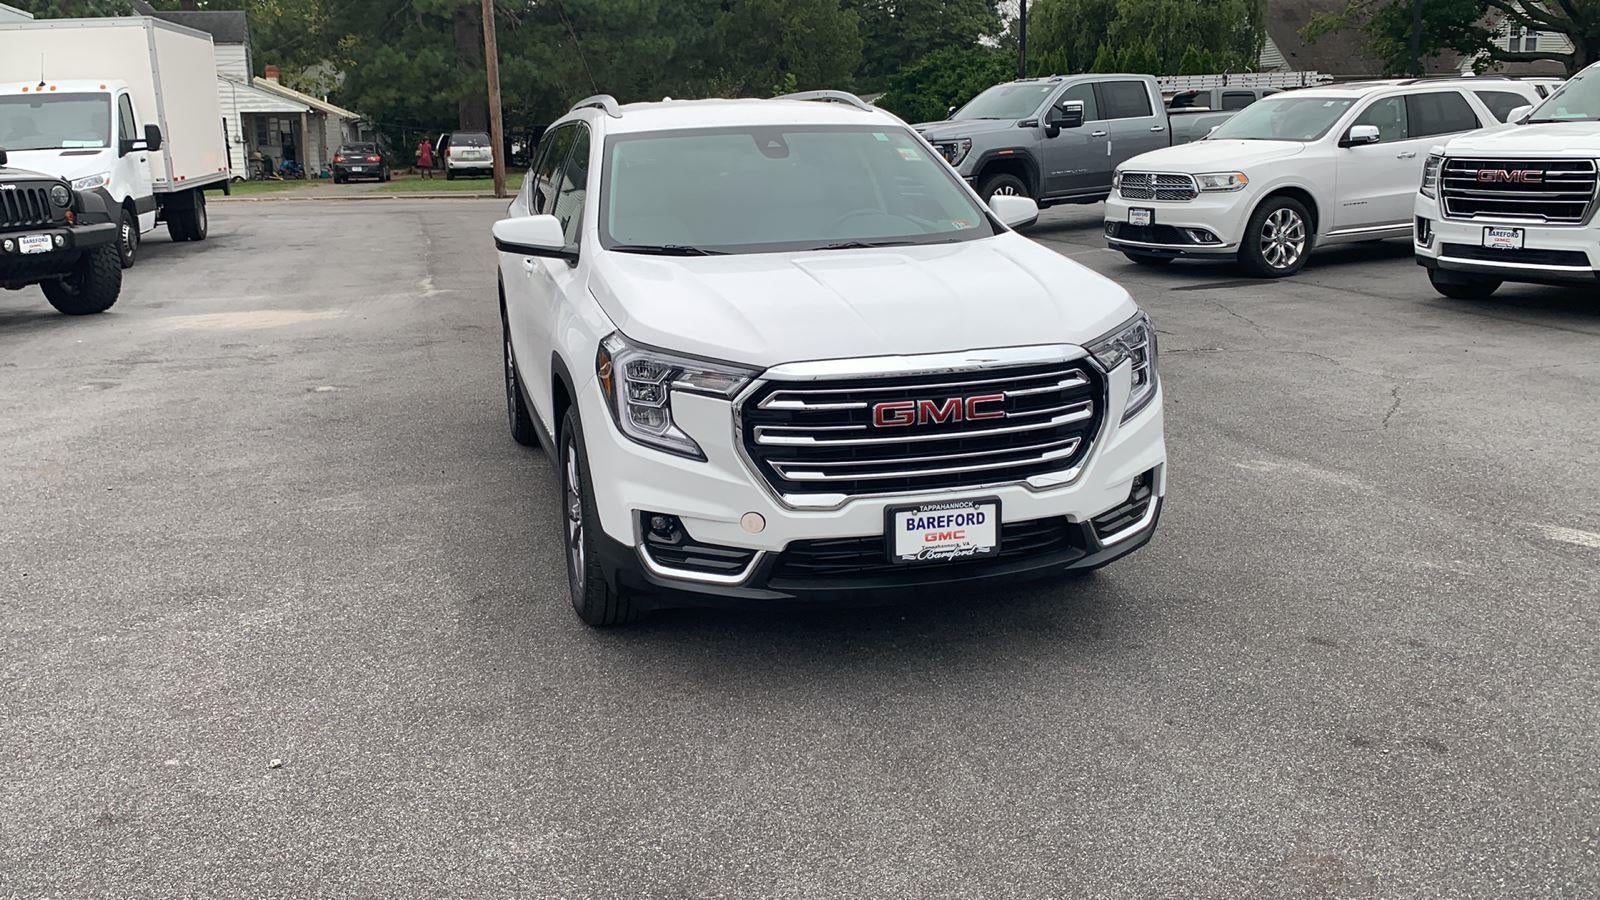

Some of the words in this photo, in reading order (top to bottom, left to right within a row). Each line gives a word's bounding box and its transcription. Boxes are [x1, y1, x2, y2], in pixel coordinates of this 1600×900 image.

[1477, 169, 1544, 184] GMC
[872, 393, 1005, 428] GMC
[919, 501, 974, 512] TAPPAHANNOCK
[906, 512, 985, 531] BAREFORD
[924, 530, 966, 542] GMC
[917, 544, 977, 561] Bareford
